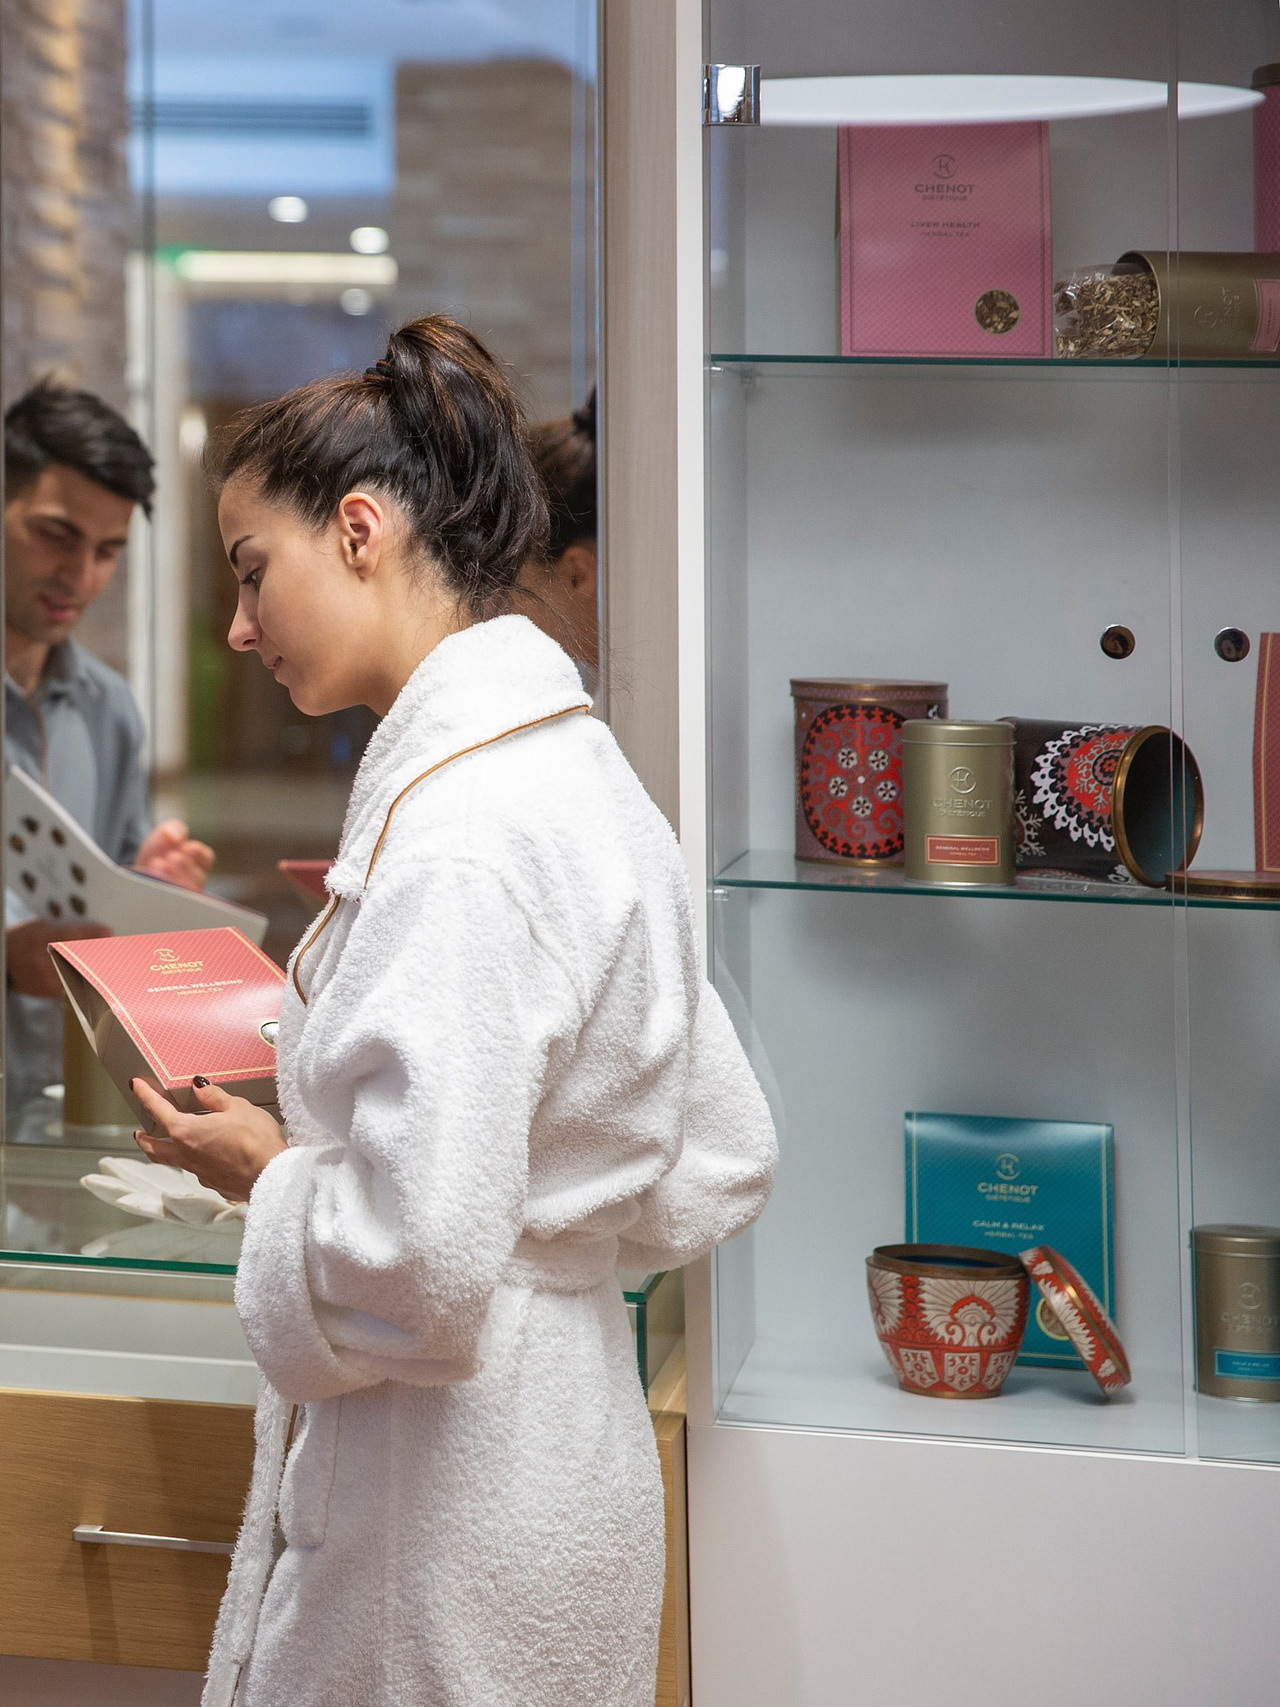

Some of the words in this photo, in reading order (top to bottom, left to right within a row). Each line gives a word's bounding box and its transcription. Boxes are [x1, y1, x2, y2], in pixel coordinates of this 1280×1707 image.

[915, 183, 973, 193] CHENOT
[942, 221, 980, 229] HEALTH
[933, 799, 992, 809] CHENOT
[150, 960, 204, 971] CHENOT
[147, 985, 190, 993] GENERAL
[190, 979, 243, 988] WELLBEING
[977, 1182, 1039, 1196] CHENOT
[972, 1220, 1000, 1228] CALM
[1011, 1222, 1045, 1231] RELAX
